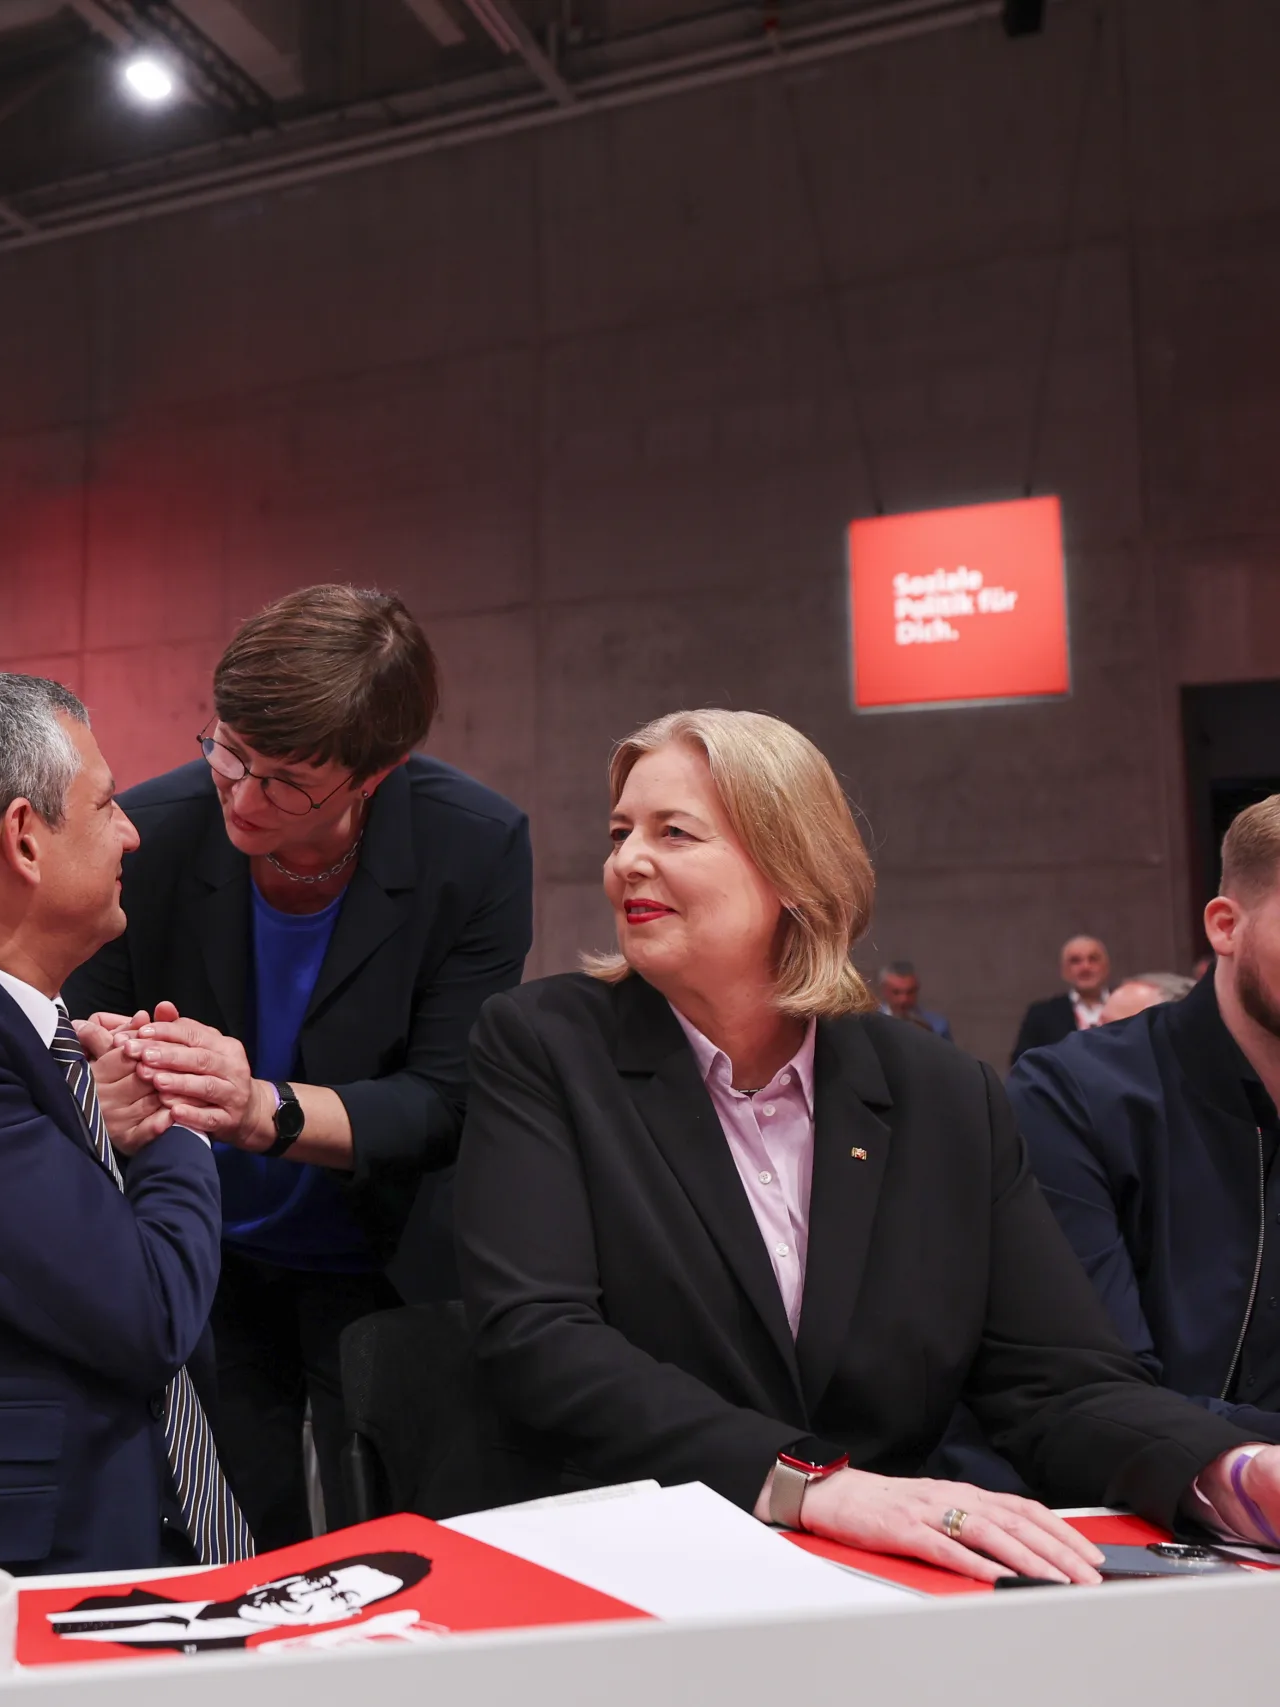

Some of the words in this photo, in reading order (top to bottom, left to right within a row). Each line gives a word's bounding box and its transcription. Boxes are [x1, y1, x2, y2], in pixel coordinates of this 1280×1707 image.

[895, 592, 974, 619] Politik
[977, 586, 1017, 613] für
[896, 618, 959, 645] Dich.
